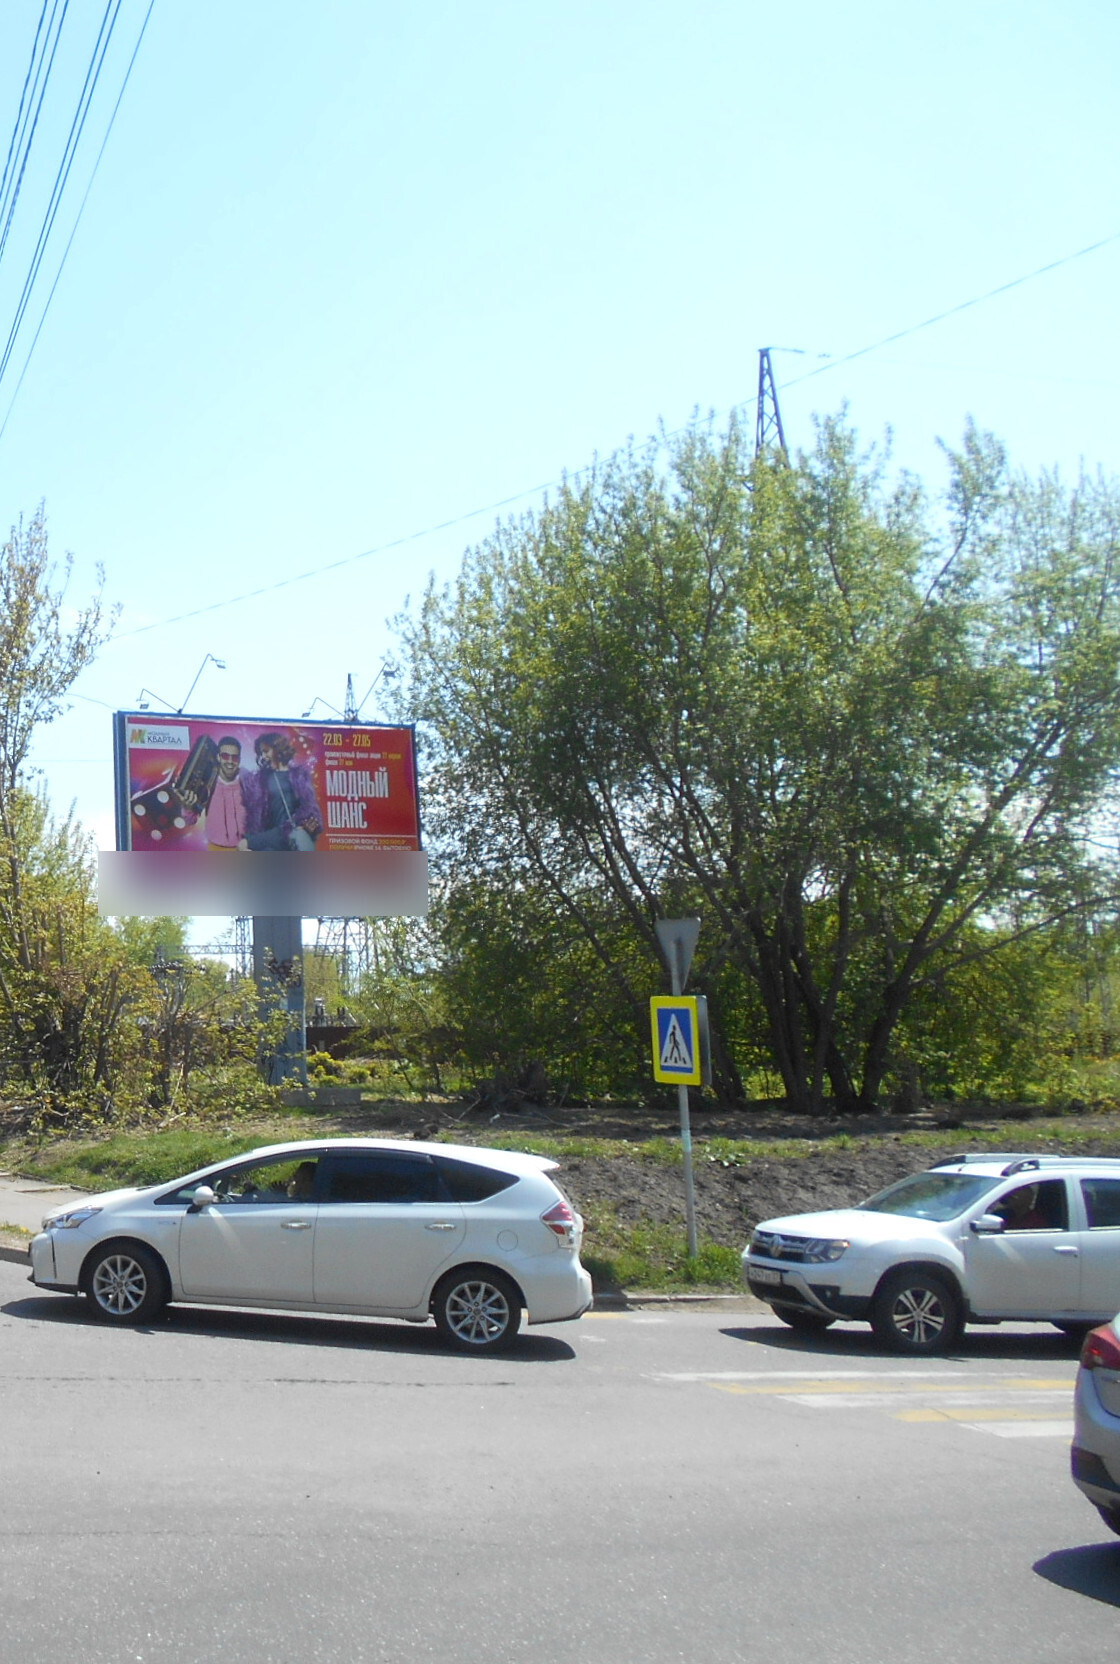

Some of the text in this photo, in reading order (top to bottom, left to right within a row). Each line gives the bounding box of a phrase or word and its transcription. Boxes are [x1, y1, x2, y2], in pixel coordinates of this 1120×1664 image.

[323, 733, 343, 746] 22.03
[352, 734, 371, 747] 27.05
[325, 766, 389, 801] МОДНЫЙ
[327, 801, 368, 829] ШАНС
